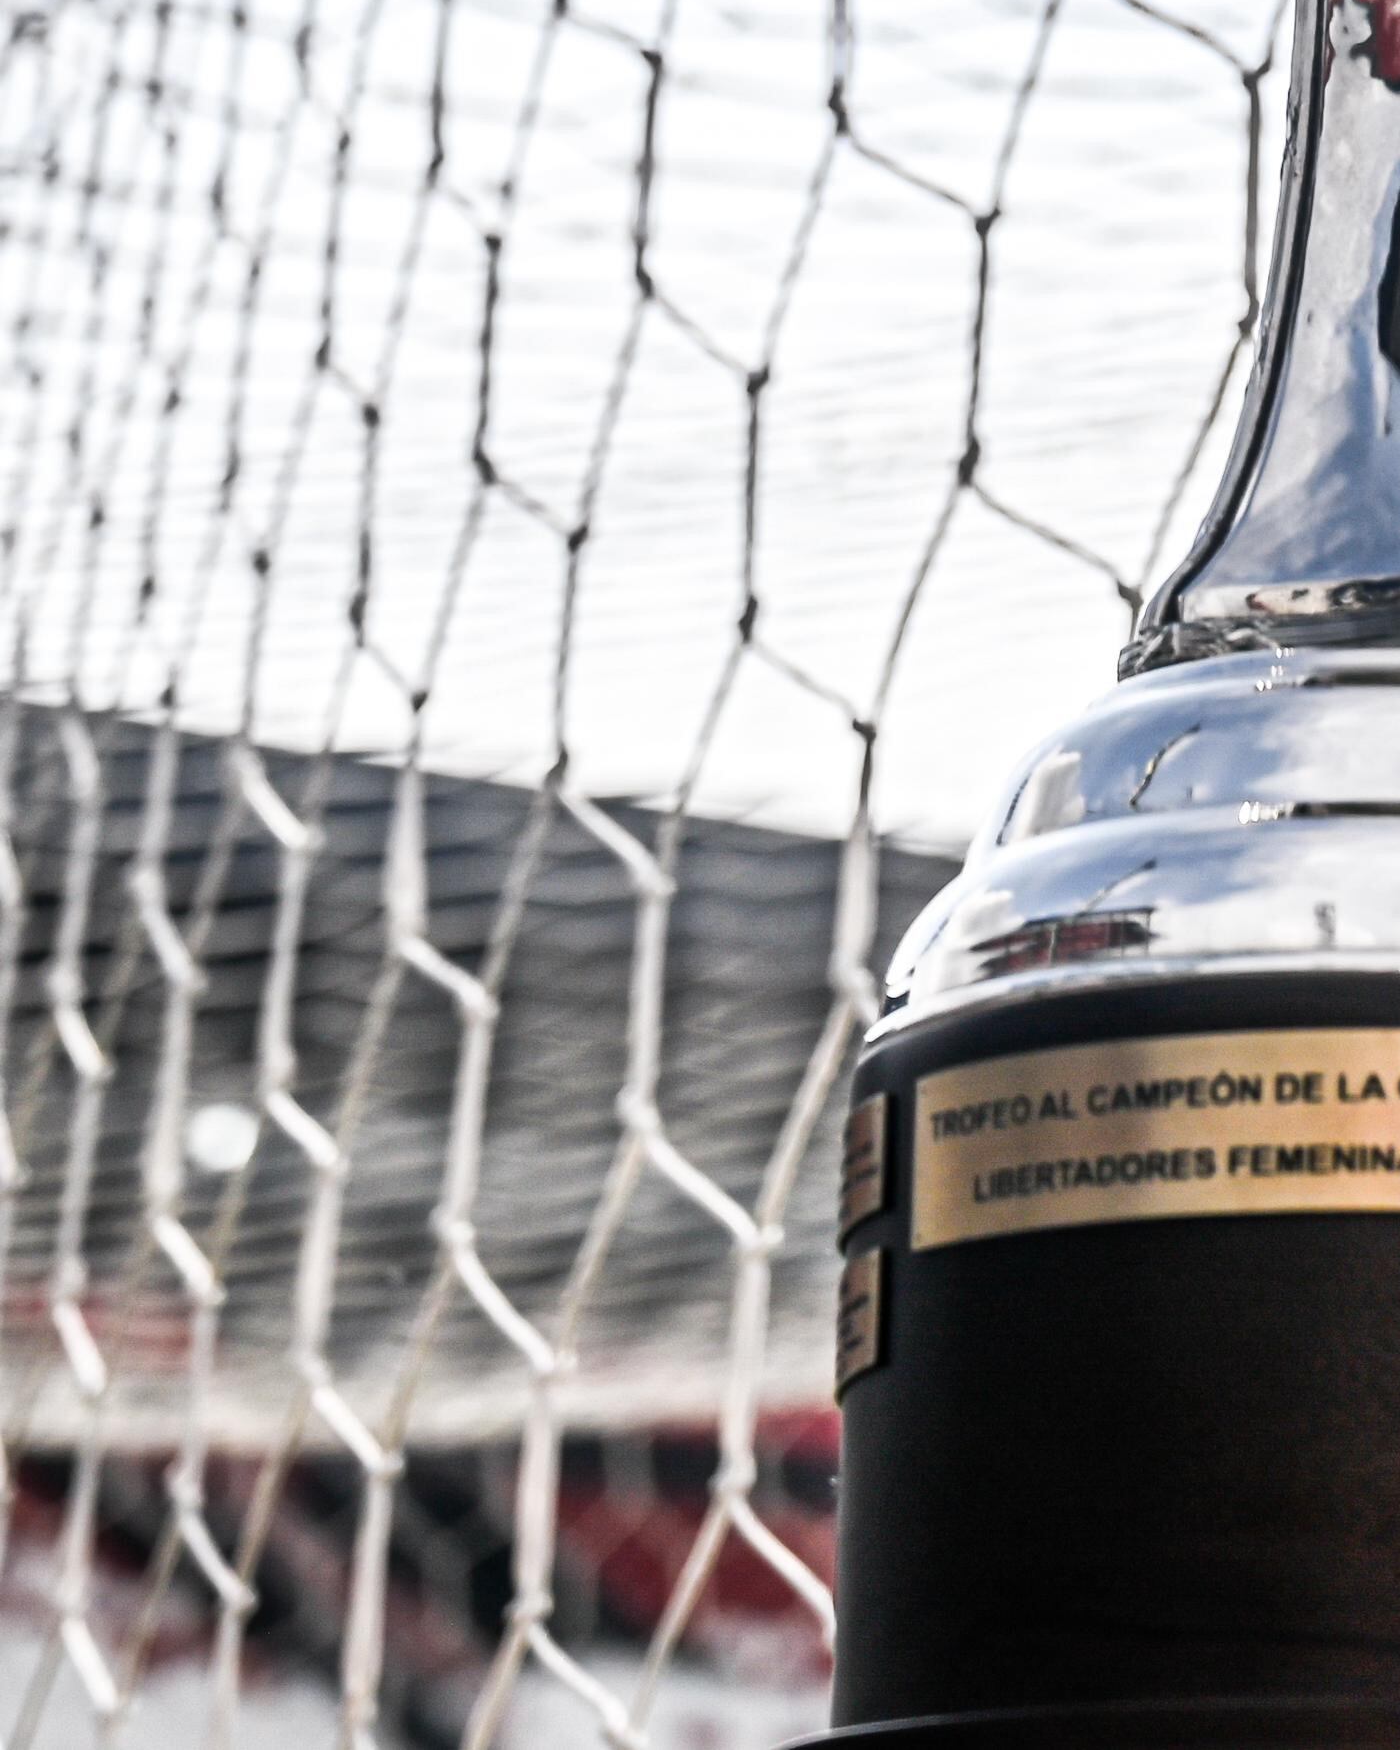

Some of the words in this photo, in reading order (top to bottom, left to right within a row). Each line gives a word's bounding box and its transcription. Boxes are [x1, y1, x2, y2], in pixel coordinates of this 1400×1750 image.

[930, 1094, 1032, 1142] TROFEO
[1039, 1089, 1077, 1121] AL
[1275, 1072, 1323, 1104] DE
[1338, 1071, 1386, 1103] LA
[973, 1146, 1216, 1205] LIBERTADORES
